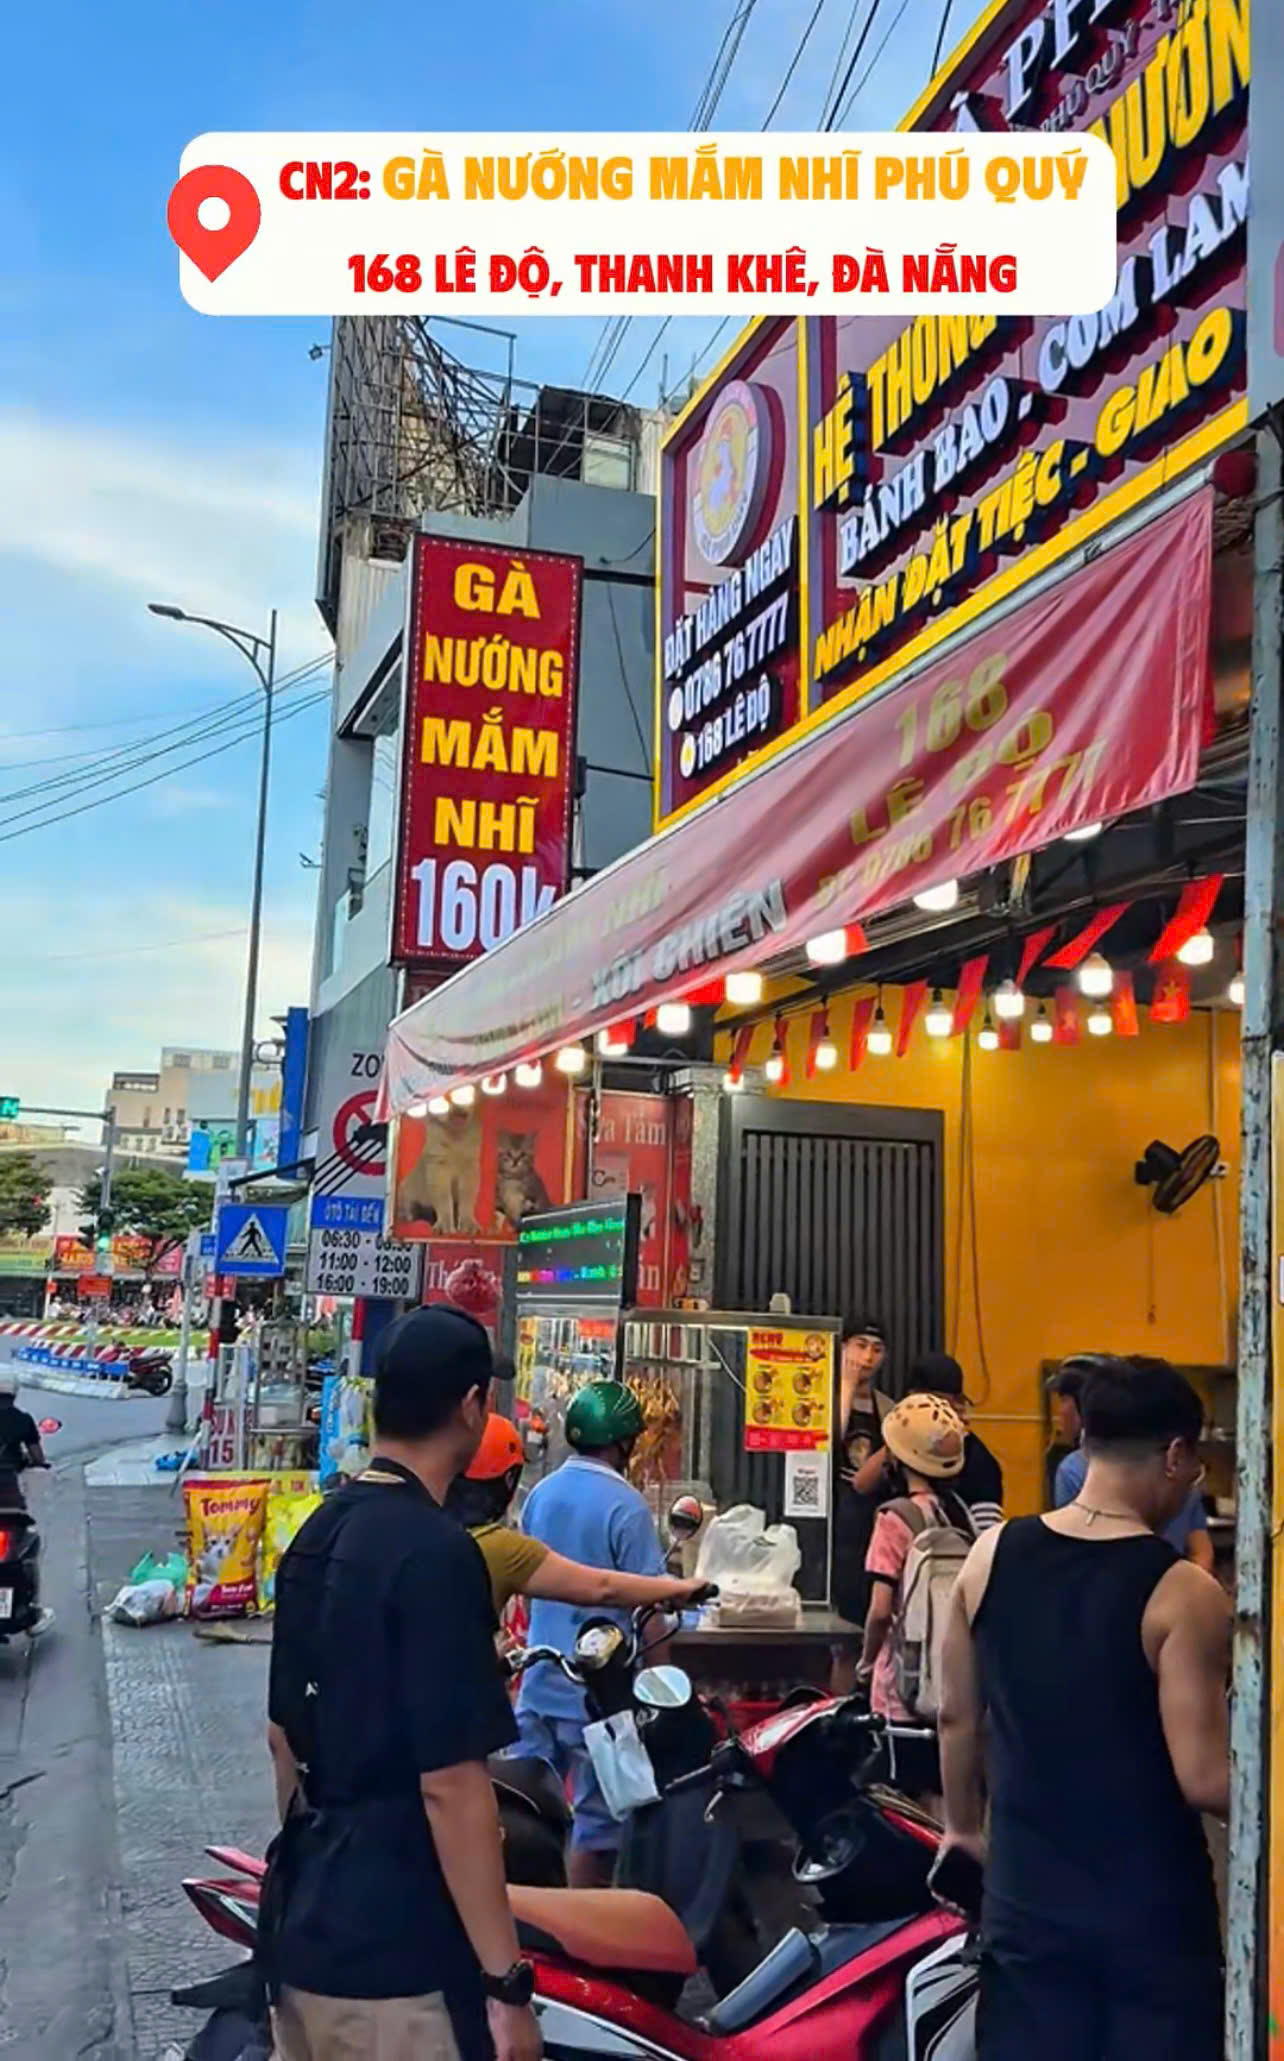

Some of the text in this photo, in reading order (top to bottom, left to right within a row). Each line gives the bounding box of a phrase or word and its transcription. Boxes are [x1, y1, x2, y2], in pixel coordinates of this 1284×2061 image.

[813, 373, 856, 511] HỆ
[932, 377, 1009, 493] BAO
[813, 582, 898, 681] NHẬN
[977, 440, 1064, 553] TIỆC
[1095, 306, 1233, 458] GIAO
[454, 560, 541, 619] GÀ
[696, 570, 741, 652] HÀNG
[745, 516, 794, 606] NGAY
[423, 631, 564, 699] NƯỚNG
[420, 706, 560, 779] MẮM
[895, 652, 1009, 766] 168
[697, 719, 723, 770] 168
[433, 795, 540, 855] NHĨ
[316, 1273, 355, 1292] 16:00
[372, 1276, 410, 1295] 19:00
[319, 1252, 358, 1271] 11:00
[374, 1255, 412, 1274] 12:00
